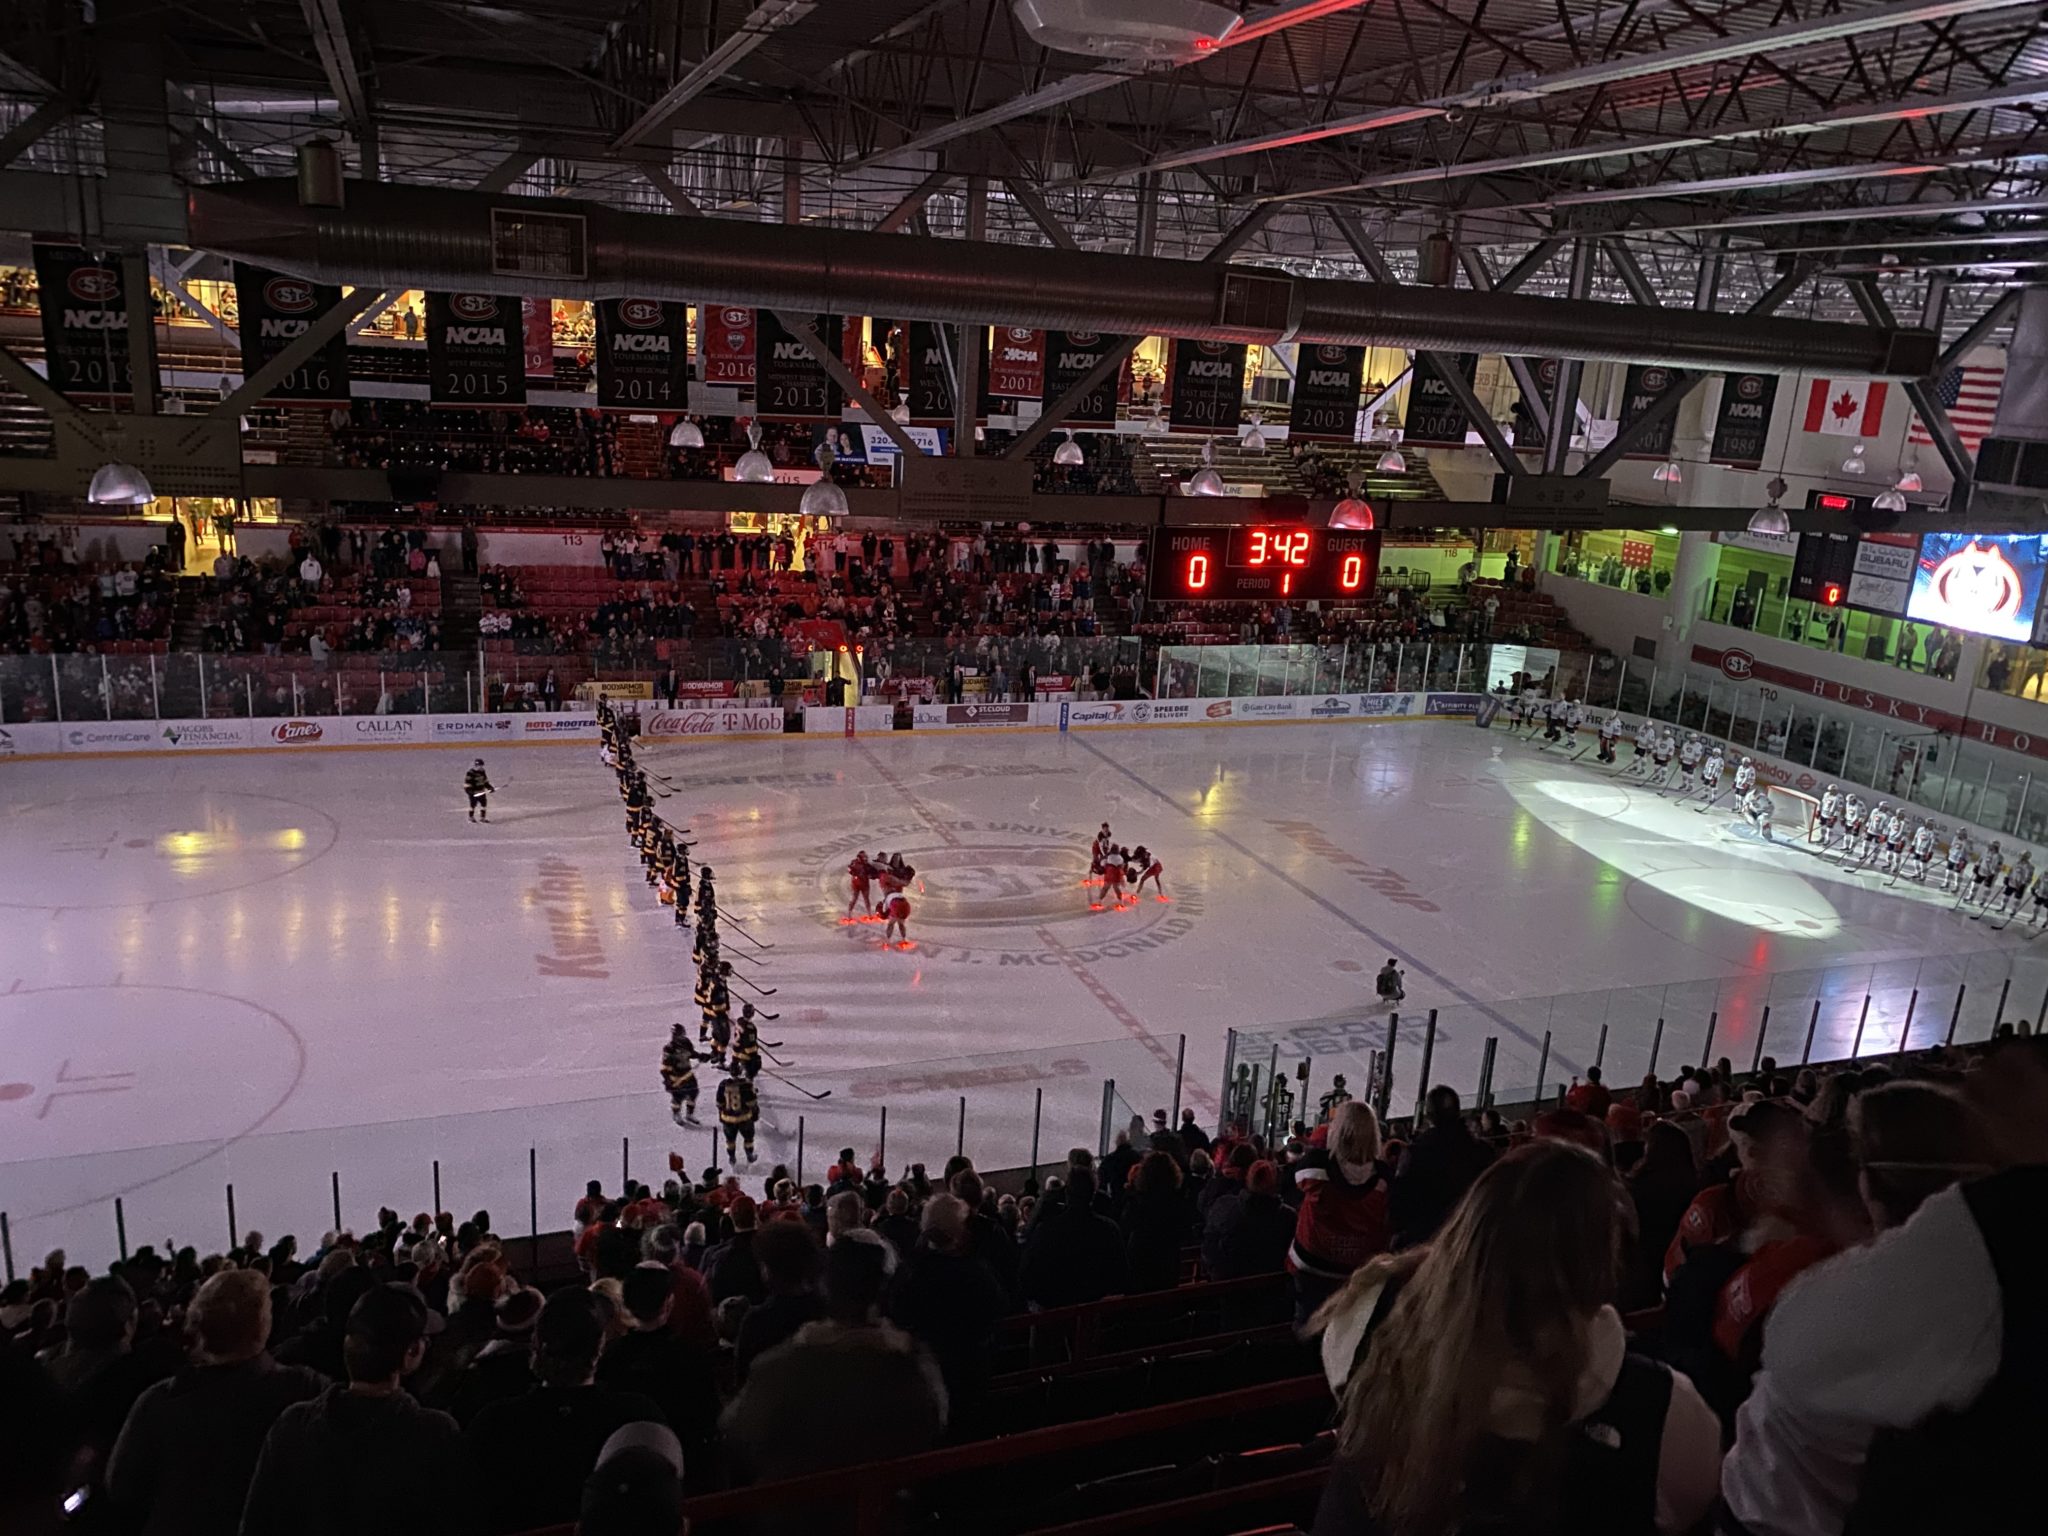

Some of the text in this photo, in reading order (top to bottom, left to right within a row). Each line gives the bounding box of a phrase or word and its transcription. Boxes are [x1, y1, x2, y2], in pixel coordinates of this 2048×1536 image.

[260, 318, 319, 338] NCA
[445, 326, 506, 346] NCAA
[613, 333, 671, 353] NCAA
[446, 345, 507, 354] TOURNAMENT
[614, 351, 671, 361] TOURNAMENT
[773, 342, 816, 360] NCA
[717, 361, 756, 377] 2016
[1188, 361, 1232, 379] NCAA
[448, 373, 508, 395] 2015
[999, 376, 1032, 391] 2001
[1307, 370, 1350, 388] NCAA
[614, 379, 671, 400] 2014
[773, 386, 826, 408] 2013
[1180, 389, 1198, 398] EAST
[1184, 400, 1229, 420] 2007
[1728, 403, 1763, 418] NCAA
[1302, 408, 1345, 428] 2003
[1417, 416, 1456, 435] 2002
[1722, 437, 1756, 454] 1989
[562, 535, 583, 547] 113
[1171, 532, 1366, 564] HOME 3:42 GUEST
[1444, 549, 1458, 558] 118
[1878, 547, 1911, 558] CLOUD
[1860, 554, 1909, 568] SUBARU
[1188, 556, 1361, 594] 0 PERIOD 1 0
[1829, 588, 1838, 603] 0
[602, 683, 644, 691] BODYARMOR
[682, 681, 724, 690] BODYARMOR
[1760, 687, 1778, 701] 120
[1811, 678, 1930, 724] HUSKY
[176, 725, 214, 733] JACOBS
[356, 720, 413, 732] CALLAN
[437, 722, 493, 731] ERDMAN
[525, 720, 597, 729] ROTO-ROOTER
[86, 732, 151, 743] CentraCare
[183, 732, 242, 741] FINANCIAL
[1750, 757, 1793, 784] Holiday
[799, 833, 872, 866] CLOUD
